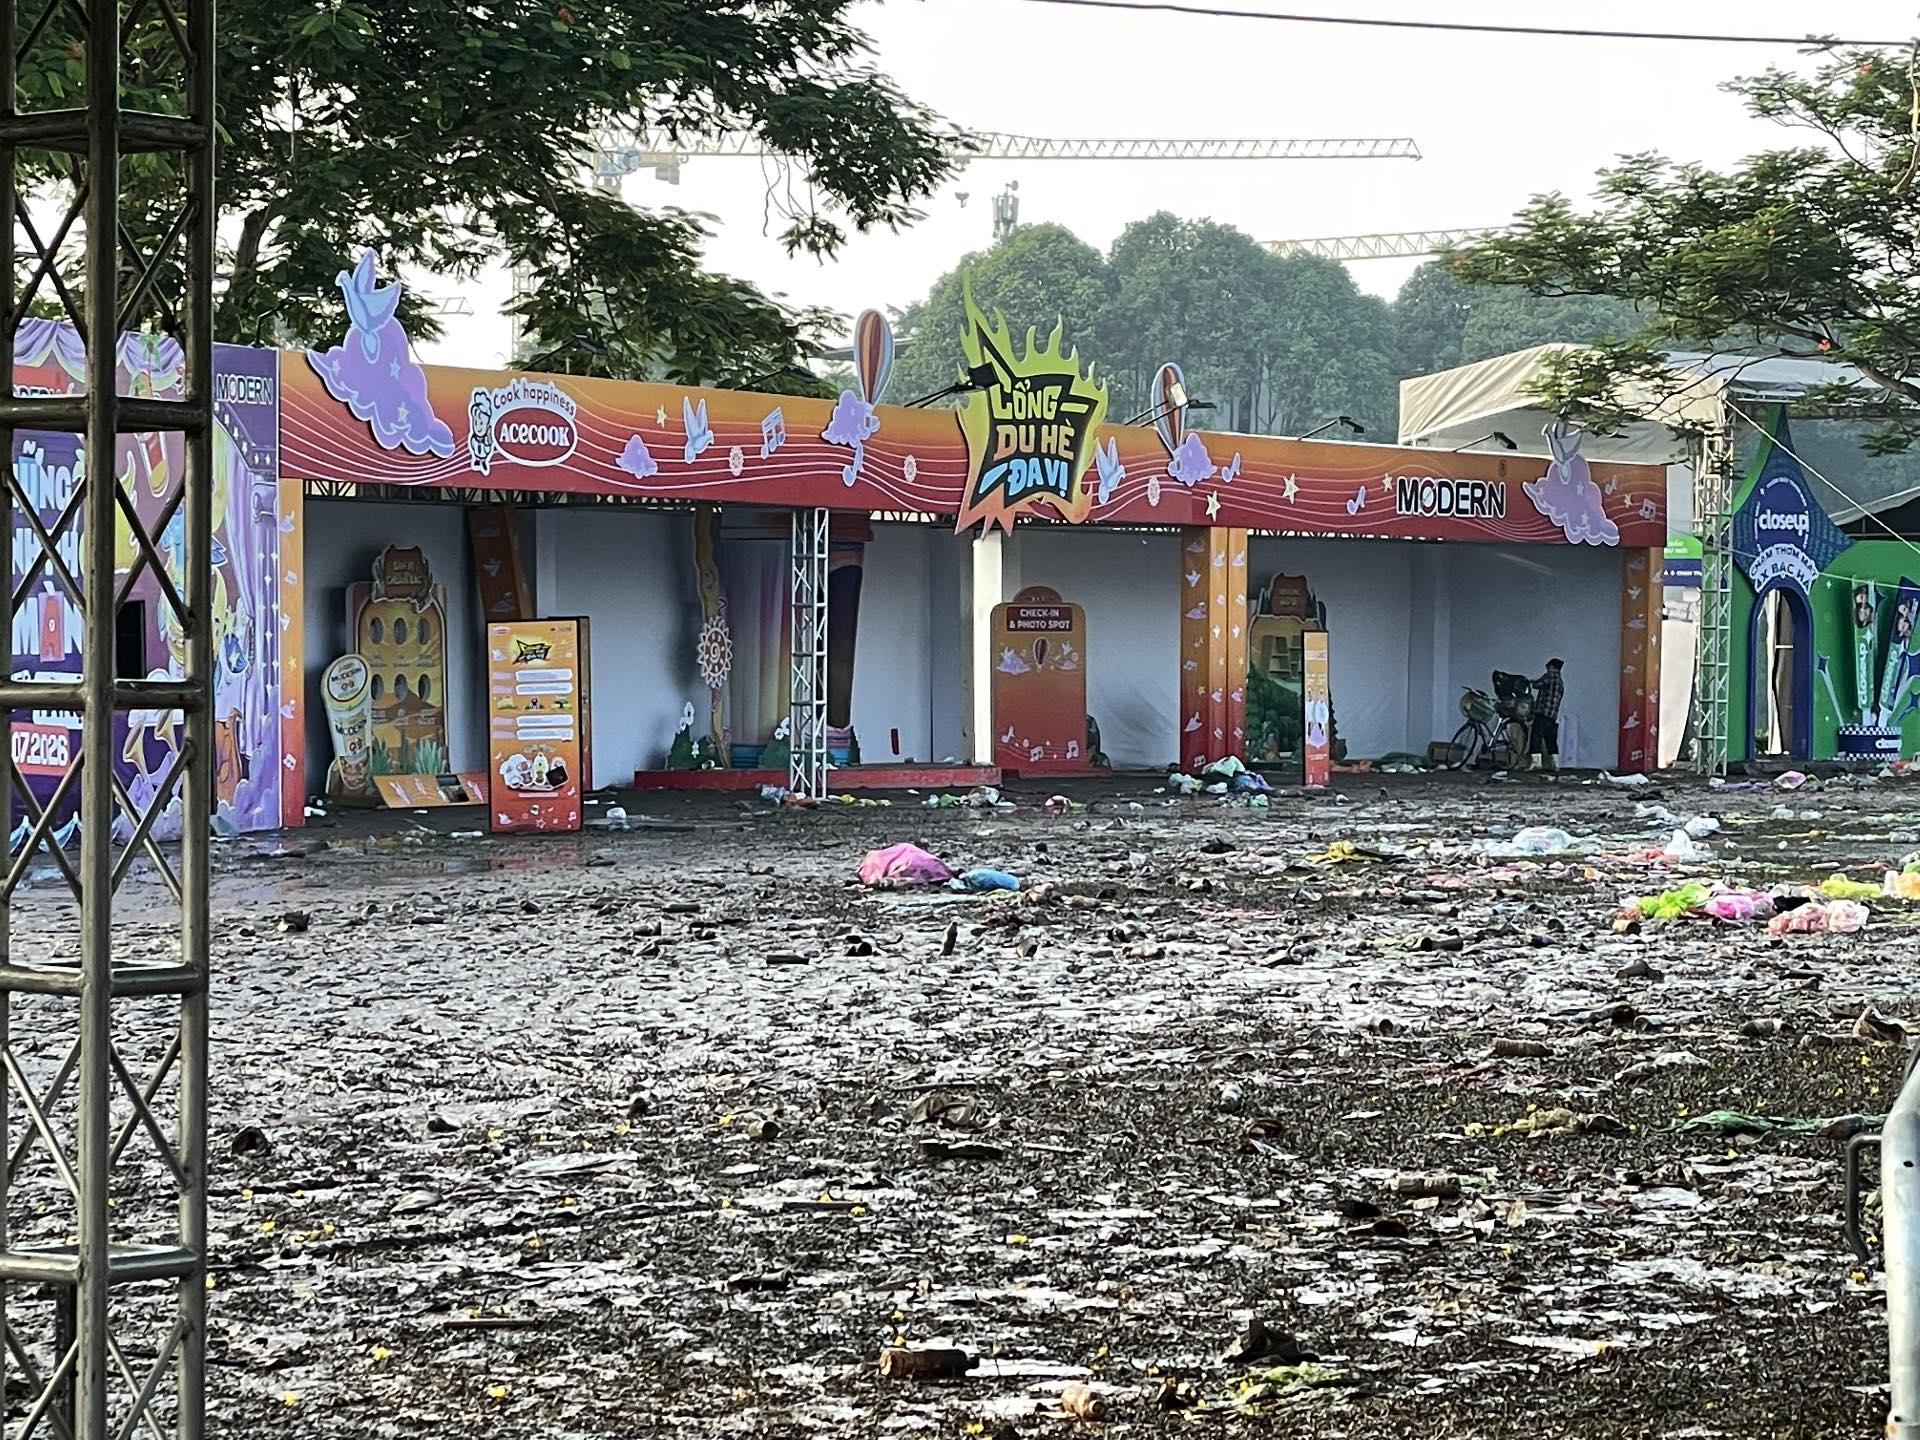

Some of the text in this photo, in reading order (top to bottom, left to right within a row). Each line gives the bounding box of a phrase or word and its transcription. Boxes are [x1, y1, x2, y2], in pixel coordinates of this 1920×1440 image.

[217, 374, 274, 405] MODERN
[493, 384, 575, 416] Cook happiness
[993, 418, 1075, 461] DU HÈ
[1397, 476, 1506, 518] MODERN
[1758, 508, 1809, 537] closeup
[1009, 620, 1070, 629] & PHOTO SPOT
[1020, 608, 1060, 617] CHECK-IN
